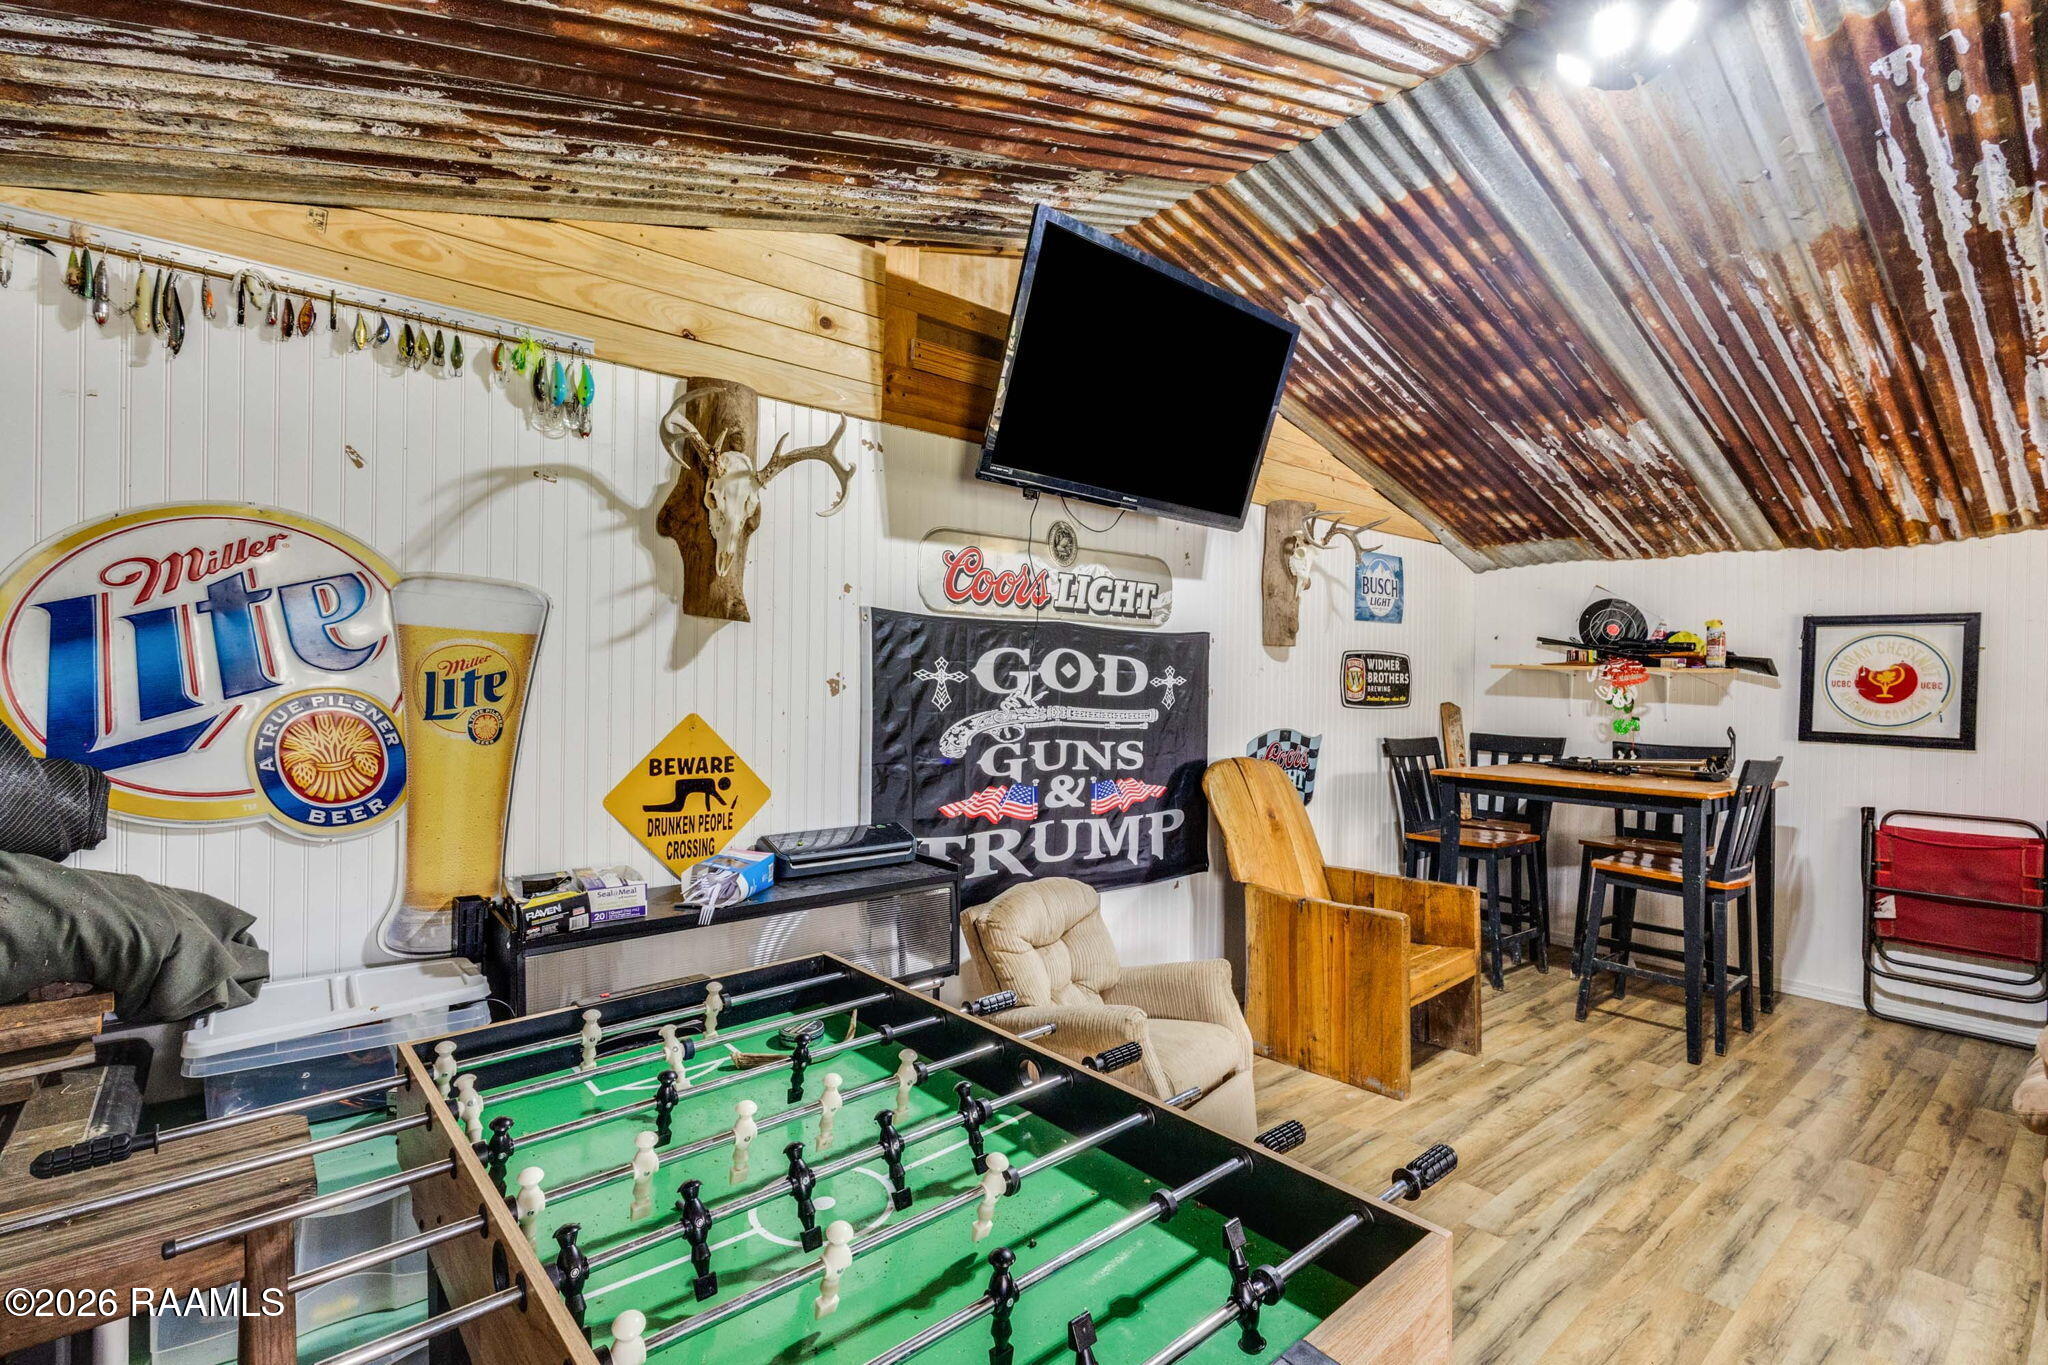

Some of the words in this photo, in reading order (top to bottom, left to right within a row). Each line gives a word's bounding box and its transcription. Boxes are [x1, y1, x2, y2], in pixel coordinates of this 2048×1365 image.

[100, 532, 288, 606] Miller
[942, 546, 1051, 609] Coors
[1054, 572, 1159, 619] LIGHT
[1362, 576, 1398, 597] BUSCH
[1370, 597, 1391, 607] LIGHT
[30, 569, 379, 772] Lite
[437, 655, 492, 676] Miller
[971, 648, 1149, 706] GOD
[1367, 658, 1400, 671] WIDMER
[1367, 672, 1409, 684] BROTHERS
[423, 668, 507, 720] Lite
[1921, 682, 1943, 690] UCBC
[258, 700, 304, 751] TRUE
[311, 696, 400, 746] PILSNER
[259, 757, 276, 772] A
[649, 756, 735, 776] BEWARE
[976, 740, 1145, 783] GUNS
[1262, 741, 1309, 769] Coors
[1044, 774, 1085, 808] &
[308, 798, 387, 825] BEER
[647, 815, 695, 837] DRUNKEN
[698, 812, 733, 833] PEOPLE
[666, 837, 715, 860] CROSSING
[916, 808, 1185, 879] TRUMP
[525, 903, 562, 921] RAVEN
